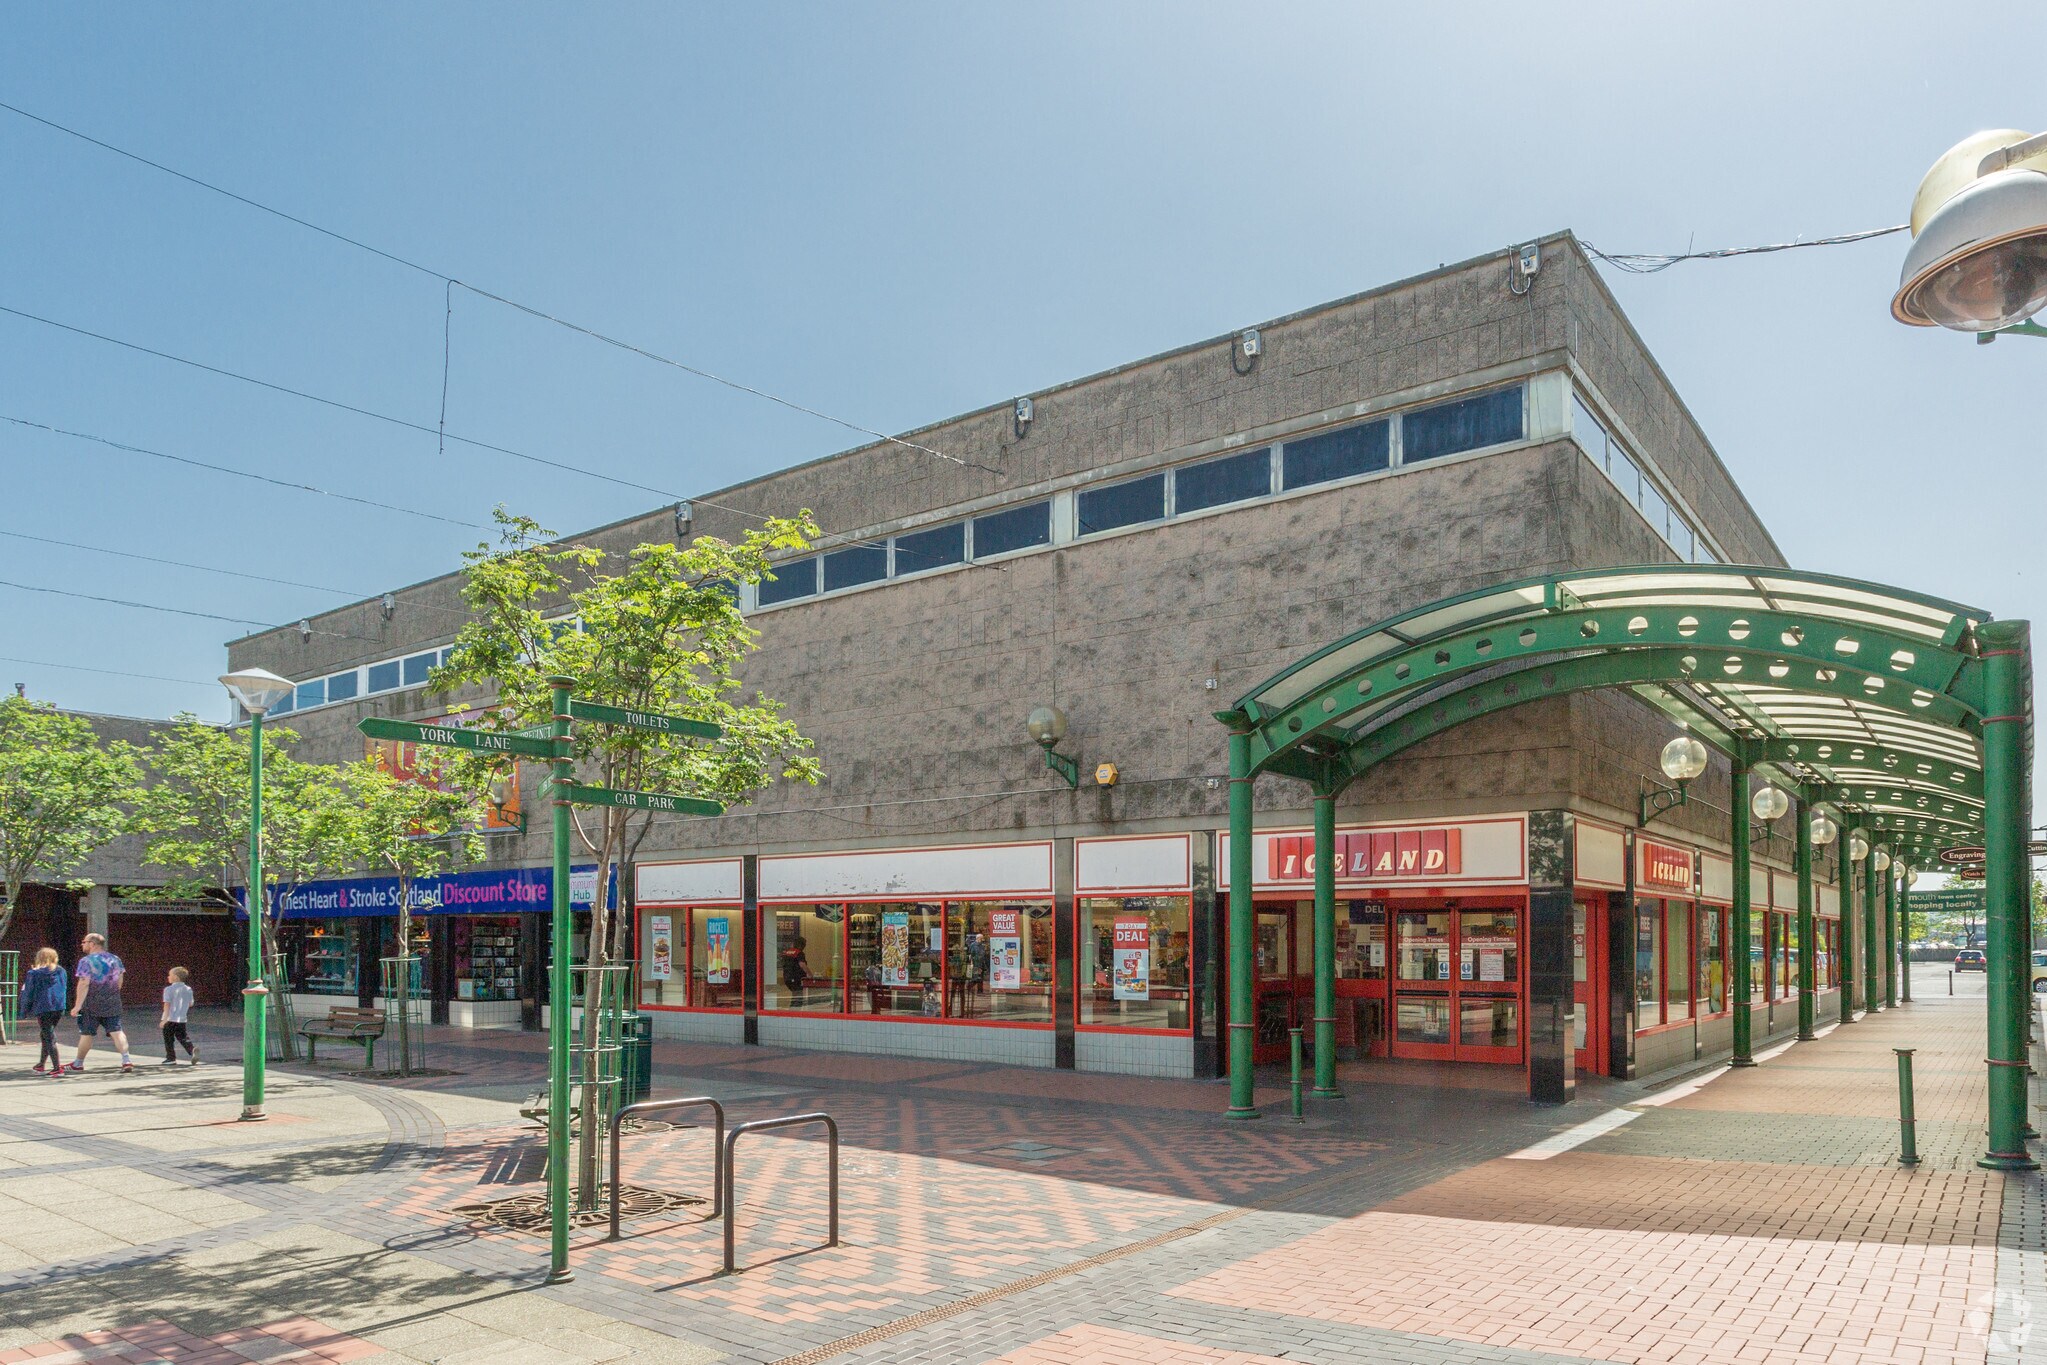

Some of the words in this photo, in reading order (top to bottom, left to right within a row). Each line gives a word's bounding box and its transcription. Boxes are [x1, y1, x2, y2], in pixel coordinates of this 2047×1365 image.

[626, 711, 670, 729] TOILETS
[420, 727, 457, 744] YORK
[475, 734, 511, 750] LANE
[615, 793, 637, 806] CAR
[648, 796, 675, 810] PARK
[1652, 861, 1689, 884] ICELAND
[309, 890, 338, 909] Heart
[339, 888, 348, 908] &
[350, 886, 386, 908] Stroke
[444, 881, 505, 905] Discount
[507, 879, 547, 902] Store
[573, 890, 591, 900] Hub
[1946, 900, 1978, 908] locally
[992, 913, 1016, 922] GREAT
[709, 921, 727, 934] ROCKET
[993, 921, 1015, 930] VALUE
[1116, 931, 1146, 942] DEAL
